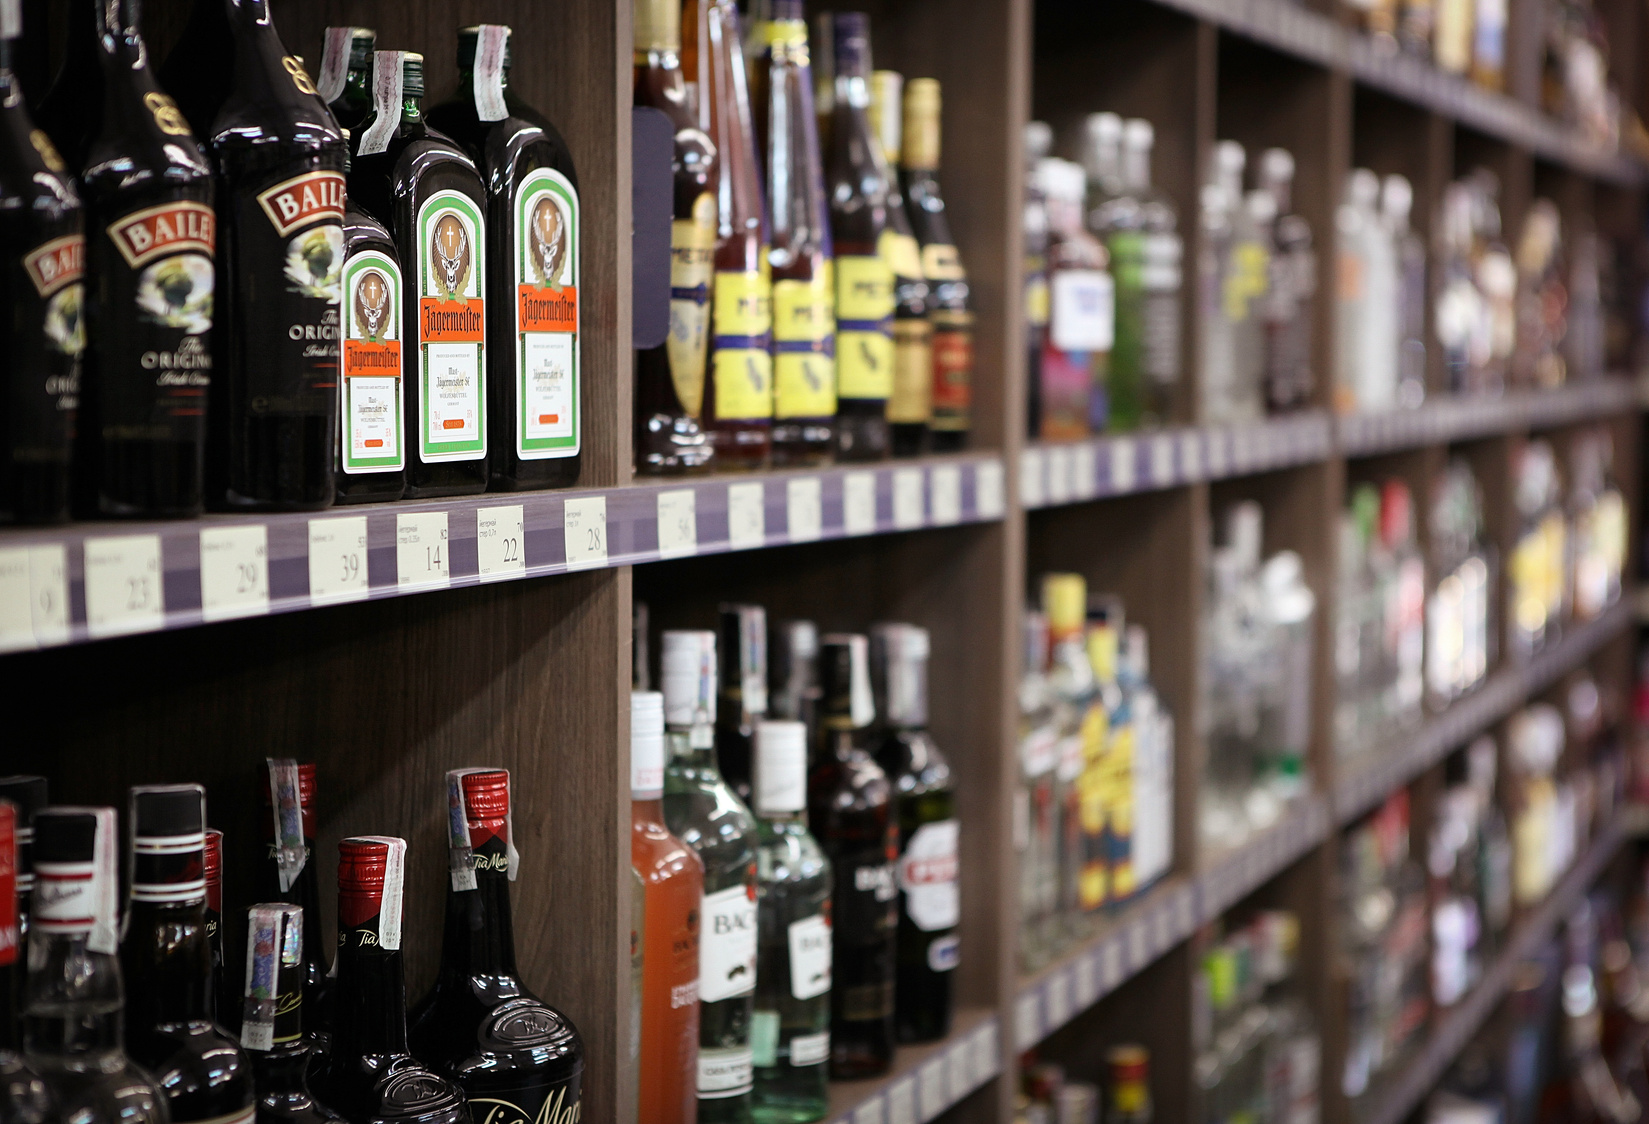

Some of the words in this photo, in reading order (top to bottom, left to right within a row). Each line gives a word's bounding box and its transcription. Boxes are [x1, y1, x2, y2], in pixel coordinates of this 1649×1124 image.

[126, 211, 213, 252] BAILE
[424, 304, 481, 339] Jägermeister
[140, 350, 212, 370] ORIGIN
[503, 537, 518, 563] 22
[587, 528, 601, 551] 28
[341, 553, 359, 582] 39
[427, 545, 442, 571] 14
[236, 562, 259, 593] 29
[472, 854, 489, 870] Tia
[356, 929, 378, 947] Tia
